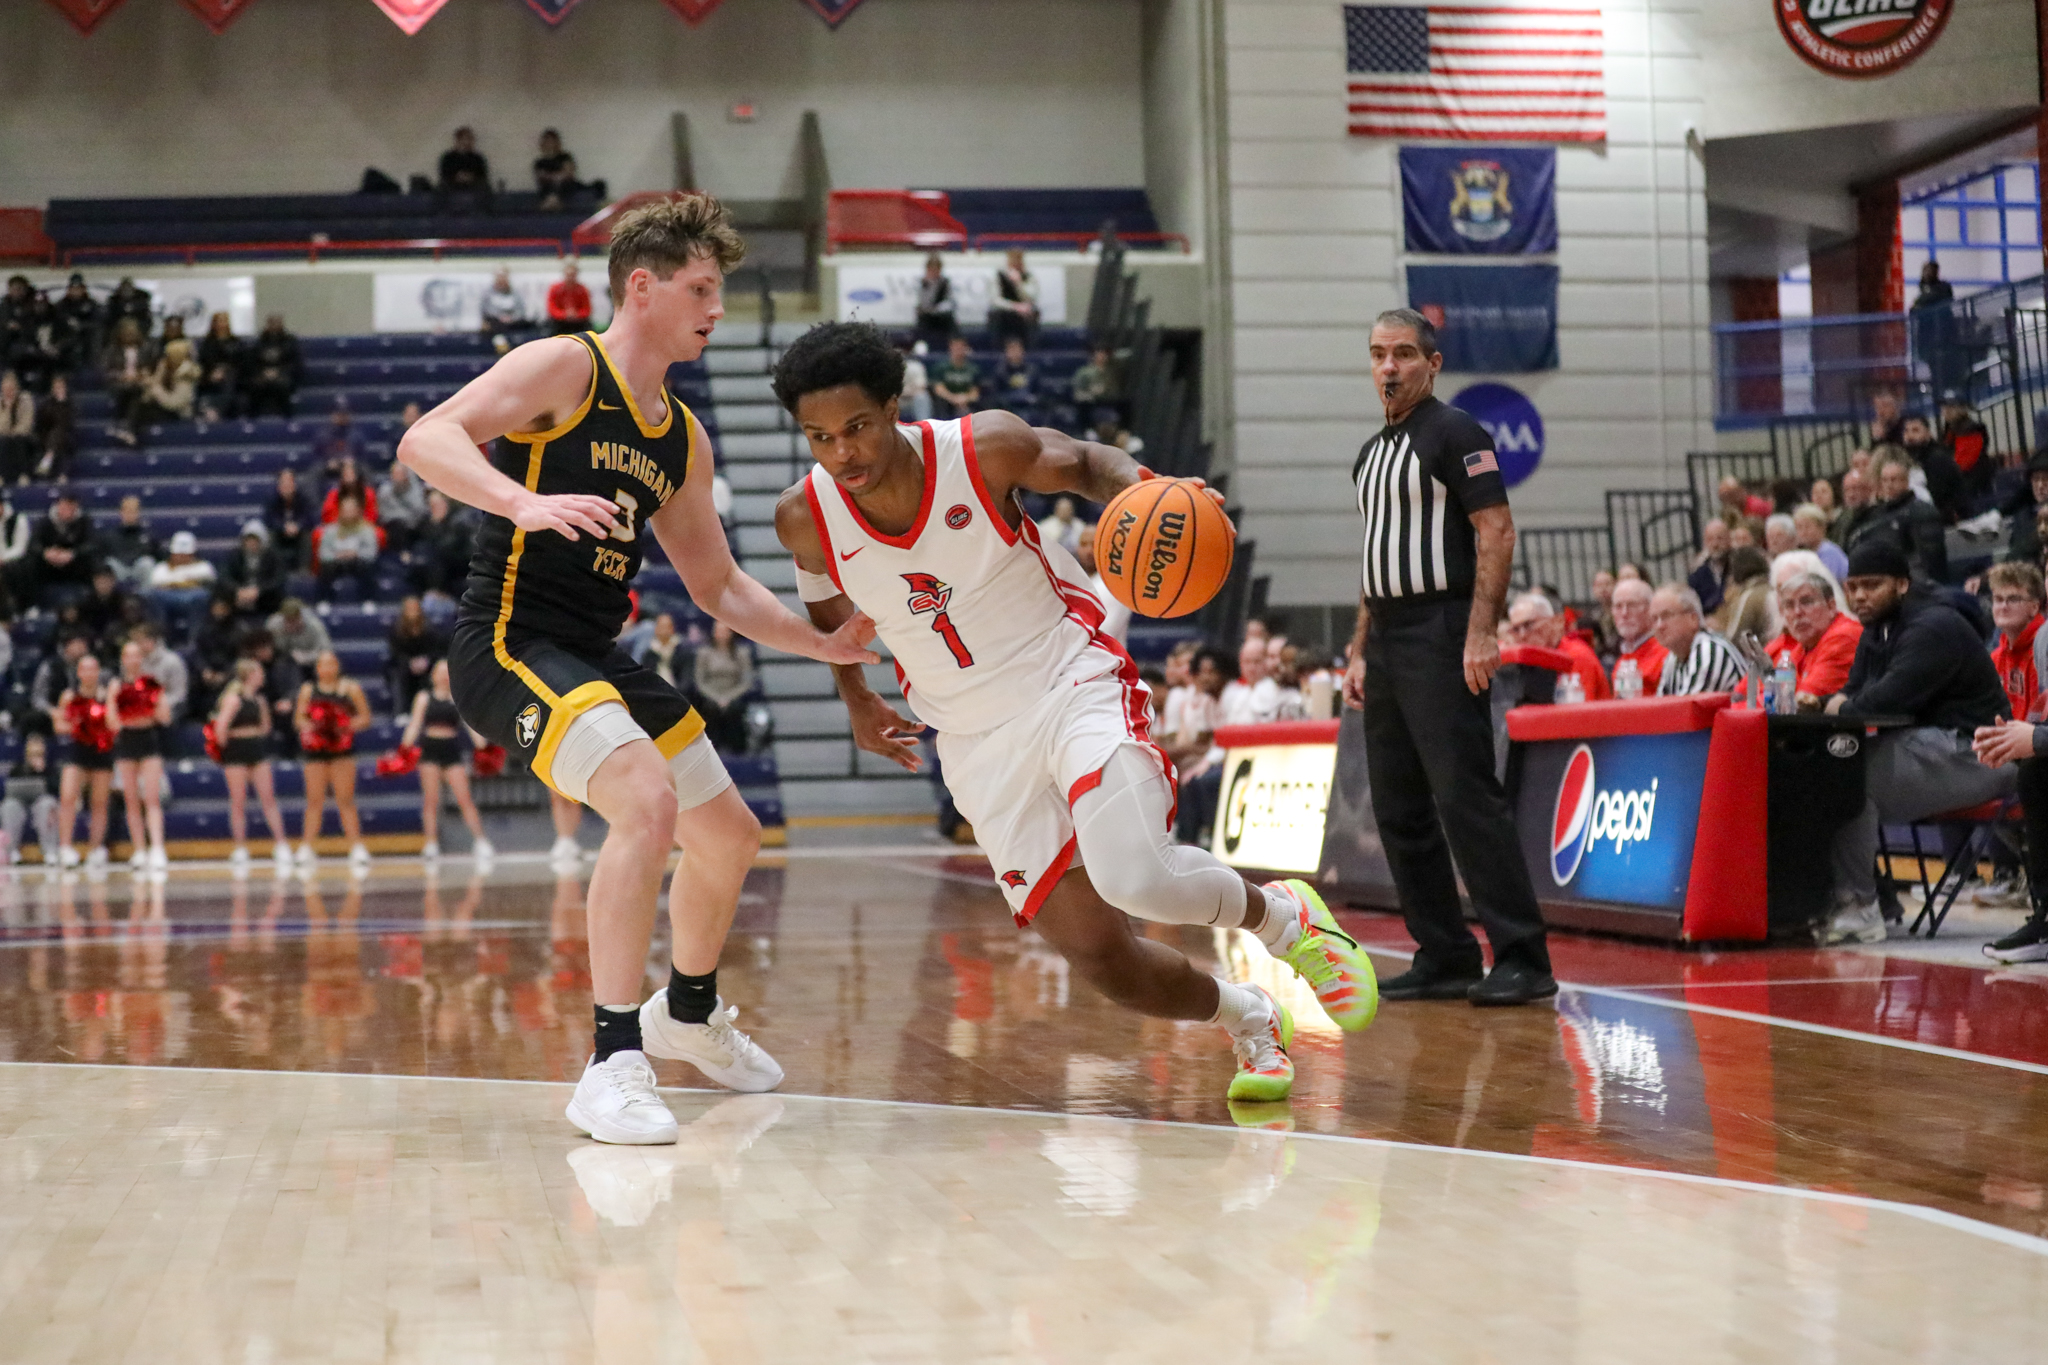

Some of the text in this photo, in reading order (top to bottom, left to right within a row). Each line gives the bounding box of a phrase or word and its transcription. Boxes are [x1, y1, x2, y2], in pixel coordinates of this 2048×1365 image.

[1854, 6, 1941, 69] CONFERENCE
[590, 441, 675, 508] MICHIGAN
[609, 488, 639, 543] 3
[1108, 511, 1138, 576] NCAA
[1142, 511, 1187, 600] Wilson
[908, 587, 952, 615] SV
[931, 611, 975, 669] 1
[1586, 775, 1659, 855] pepsi
